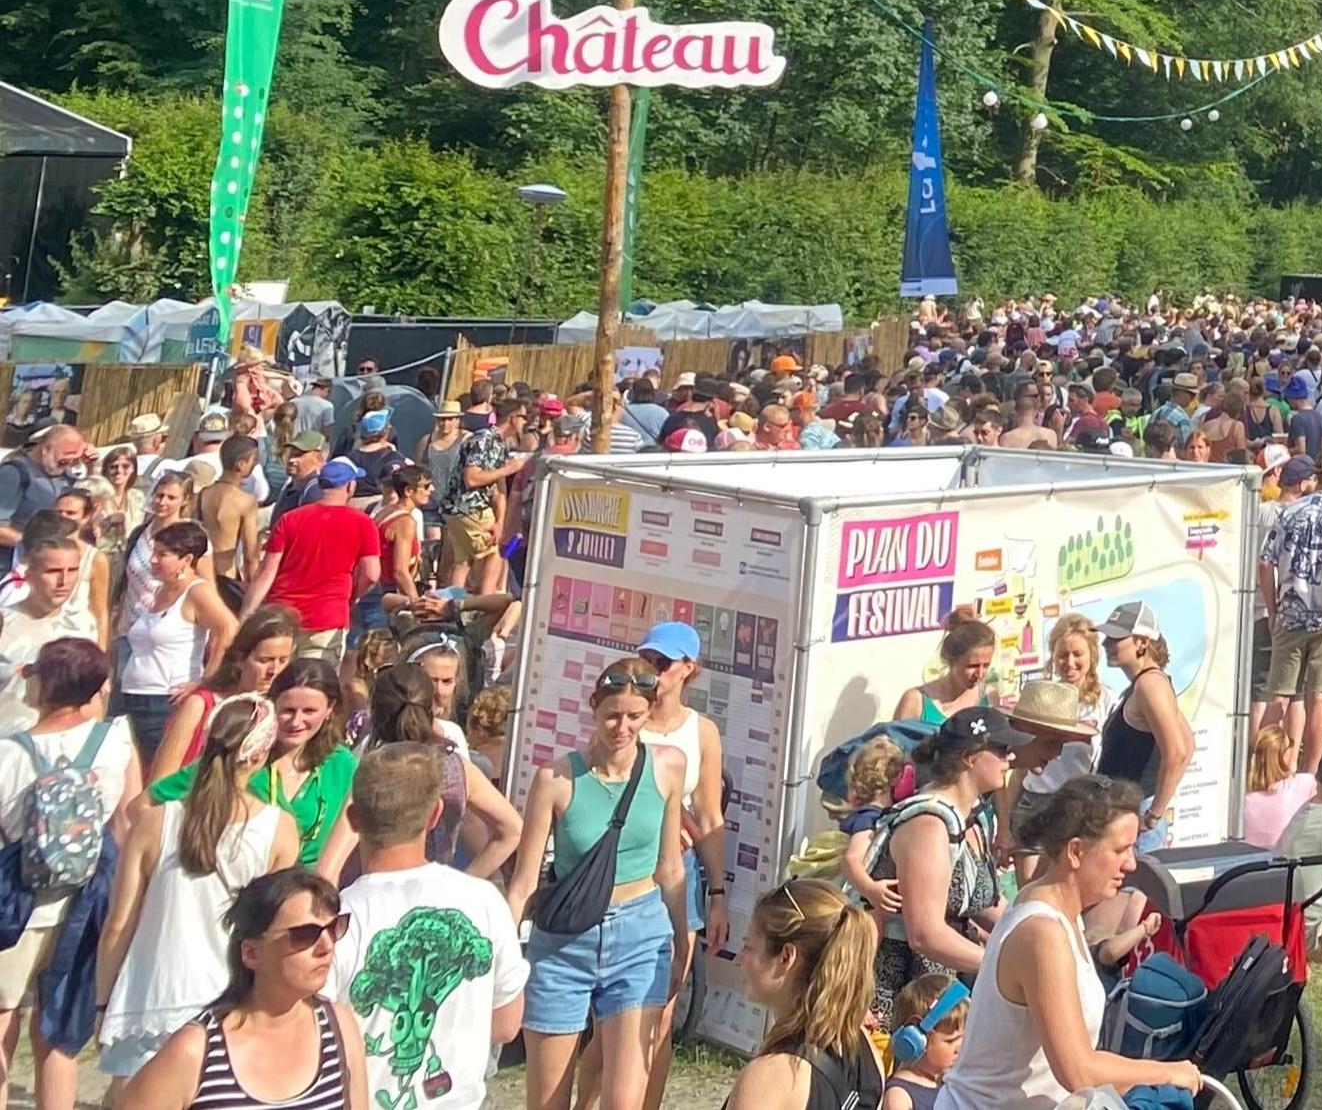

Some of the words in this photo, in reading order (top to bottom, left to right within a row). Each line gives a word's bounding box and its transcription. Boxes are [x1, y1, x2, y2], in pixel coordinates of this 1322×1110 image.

[561, 491, 621, 529] DIMANCHE
[567, 530, 575, 553] 9
[577, 531, 615, 561] JUILLET
[845, 523, 912, 579] PLAN
[915, 518, 952, 571] DU
[847, 584, 942, 639] FESTIVAL
